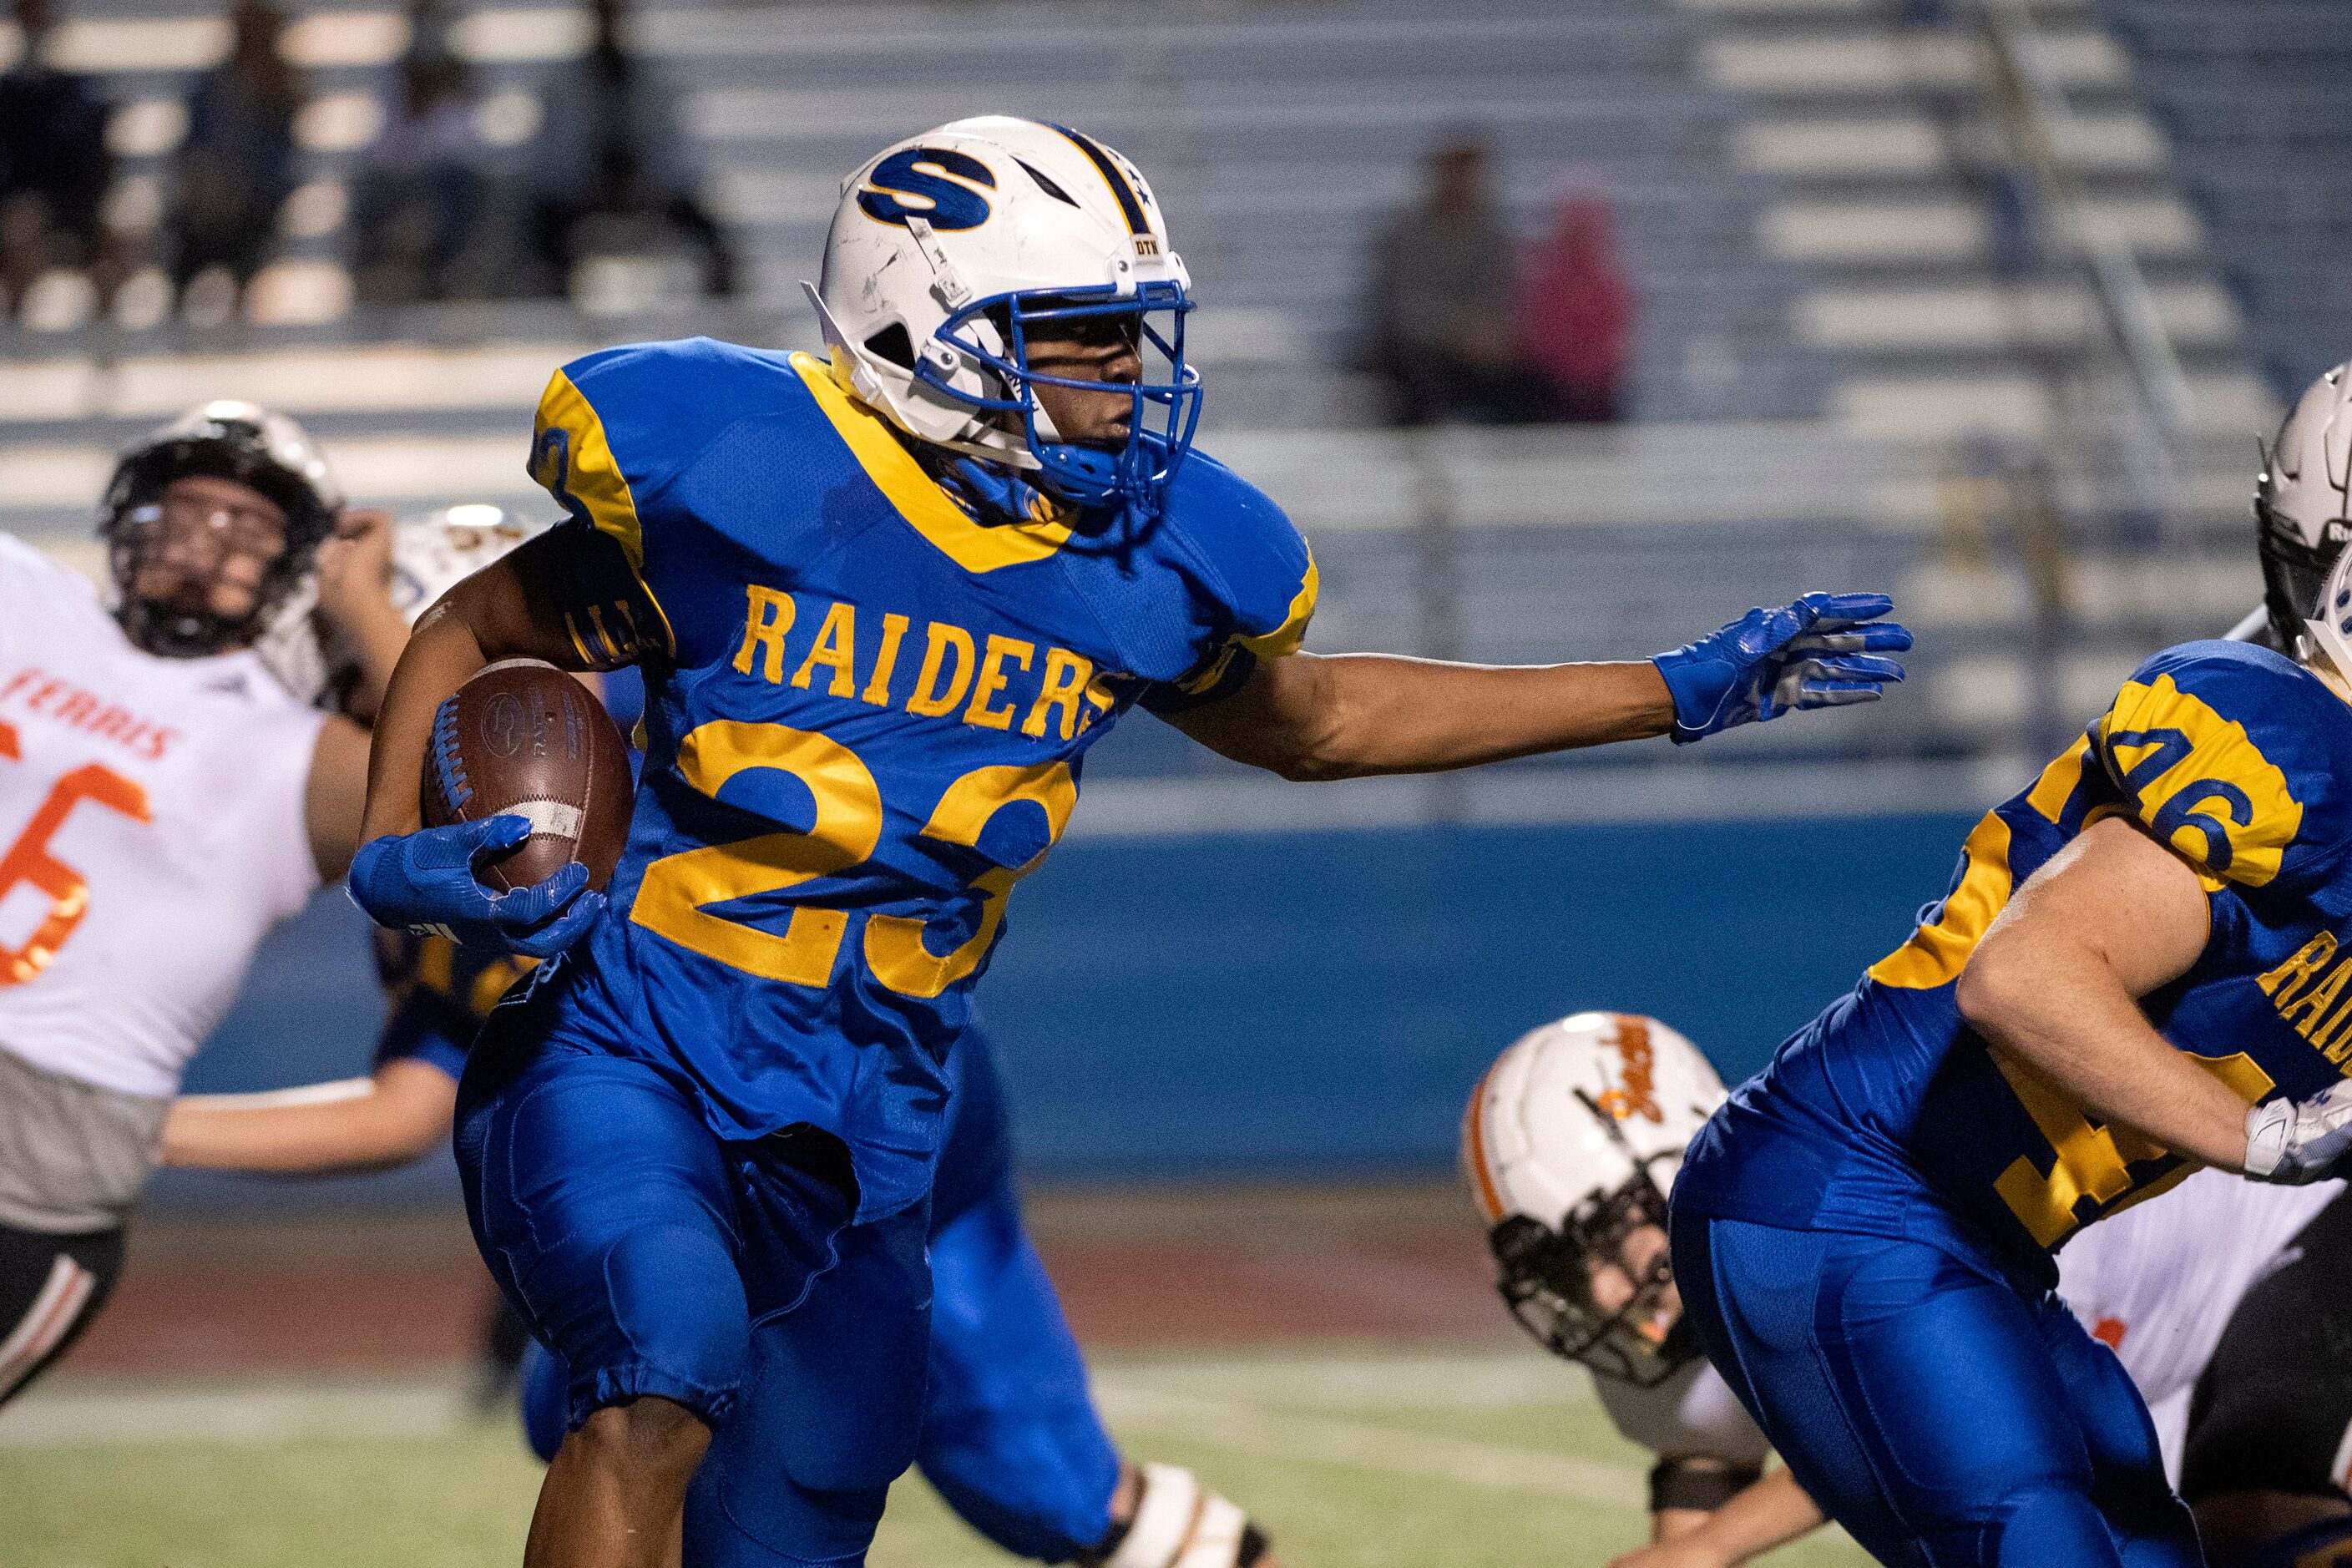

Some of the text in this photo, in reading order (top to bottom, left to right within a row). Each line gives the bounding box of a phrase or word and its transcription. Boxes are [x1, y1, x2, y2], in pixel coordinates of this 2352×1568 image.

[857, 147, 999, 233] S
[630, 720, 1078, 998] 23
[2107, 727, 2254, 873] 46
